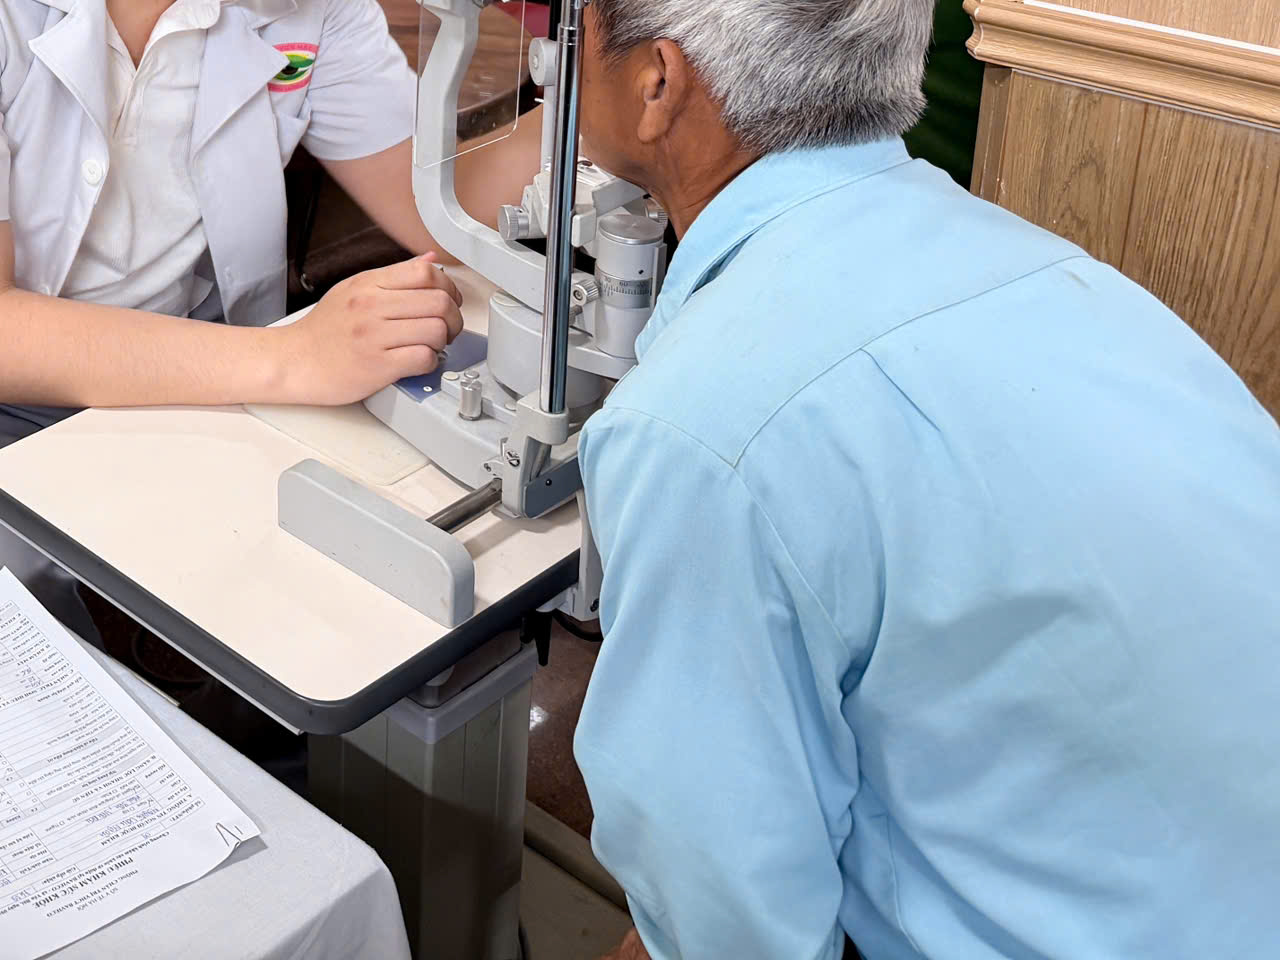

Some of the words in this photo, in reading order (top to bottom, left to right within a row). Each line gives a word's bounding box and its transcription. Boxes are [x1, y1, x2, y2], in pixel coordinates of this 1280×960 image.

[107, 857, 133, 872] PHIẾU
[78, 870, 106, 886] KHÁM
[60, 884, 78, 896] SỨC
[32, 893, 59, 907] KHỎE
